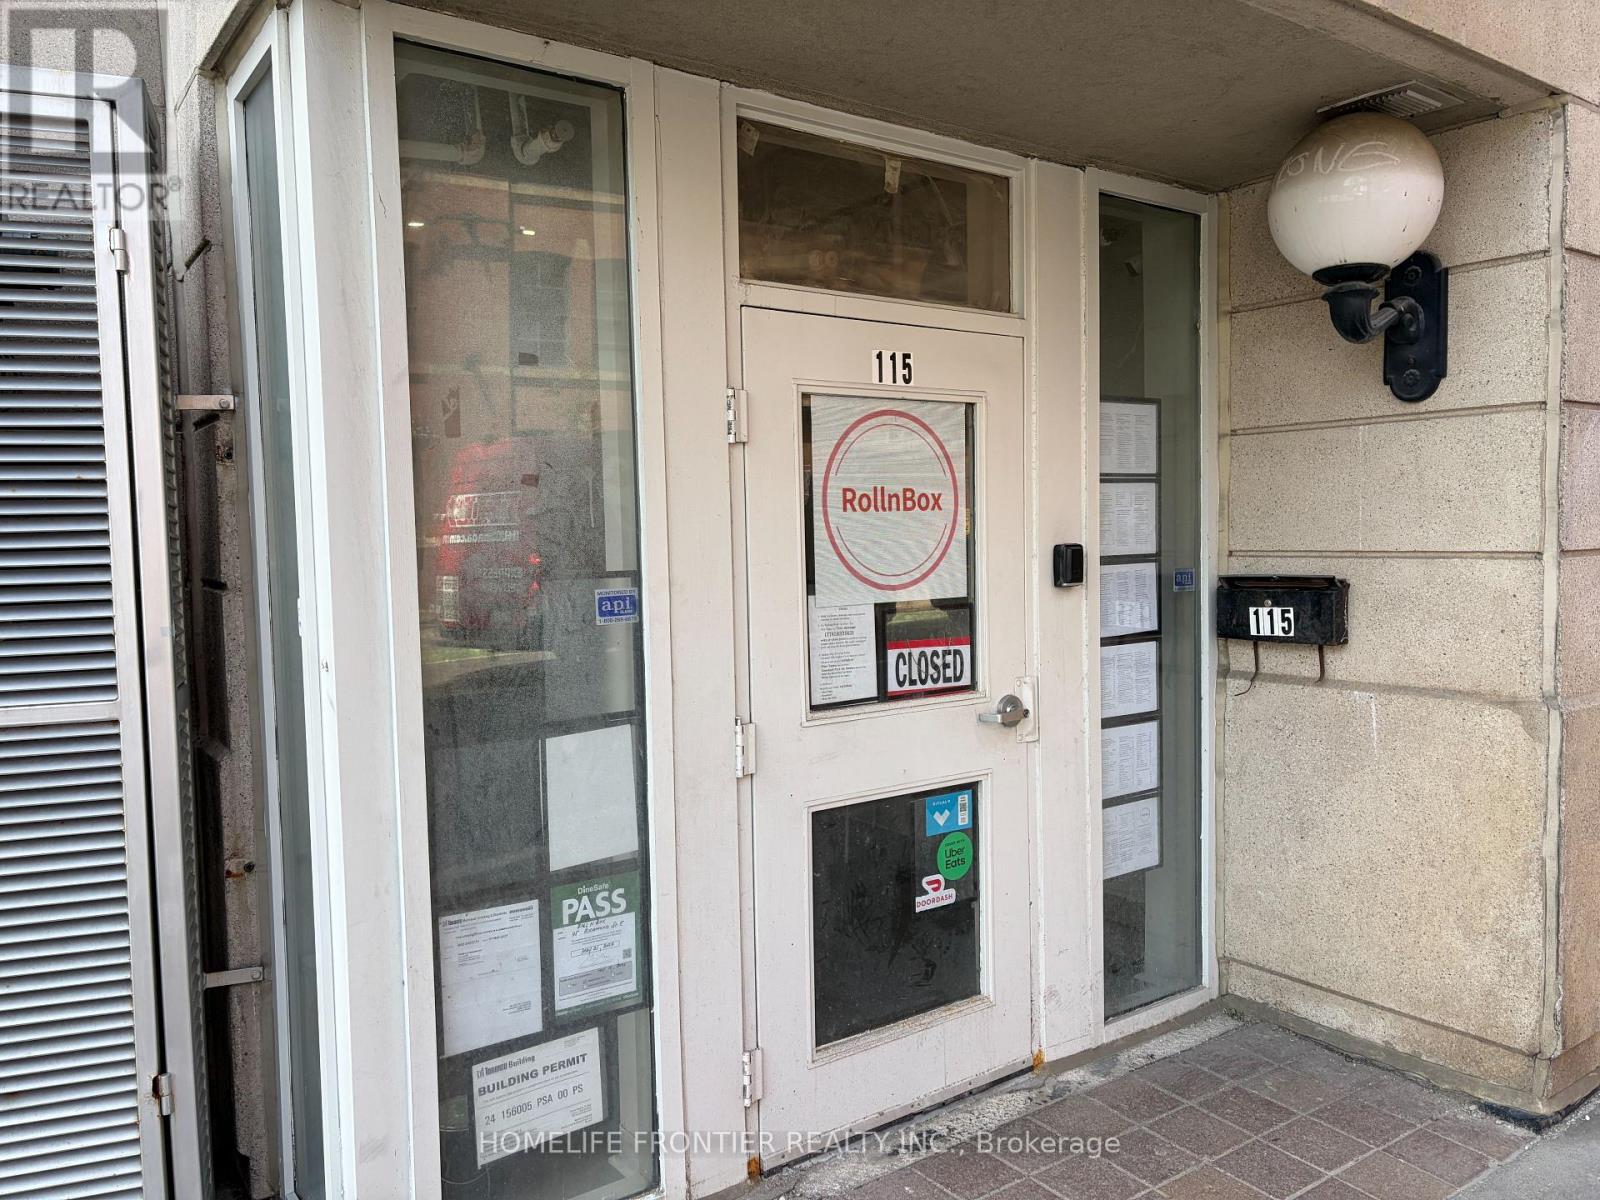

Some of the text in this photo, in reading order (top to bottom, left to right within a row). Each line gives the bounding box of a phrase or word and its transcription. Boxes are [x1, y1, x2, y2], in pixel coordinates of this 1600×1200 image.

[876, 351, 913, 385] 115
[842, 487, 942, 513] RollnBox
[1253, 608, 1293, 636] 115
[895, 649, 965, 688] CLOSED
[944, 846, 966, 859] Uber
[945, 858, 966, 870] Eats
[578, 883, 609, 894] DineSafe
[917, 893, 953, 908] DOORDASH
[562, 888, 627, 924] PASS
[478, 1053, 588, 1097] BUILDING PERMIT
[485, 1084, 584, 1126] 24 156005 PSA 00 PS
